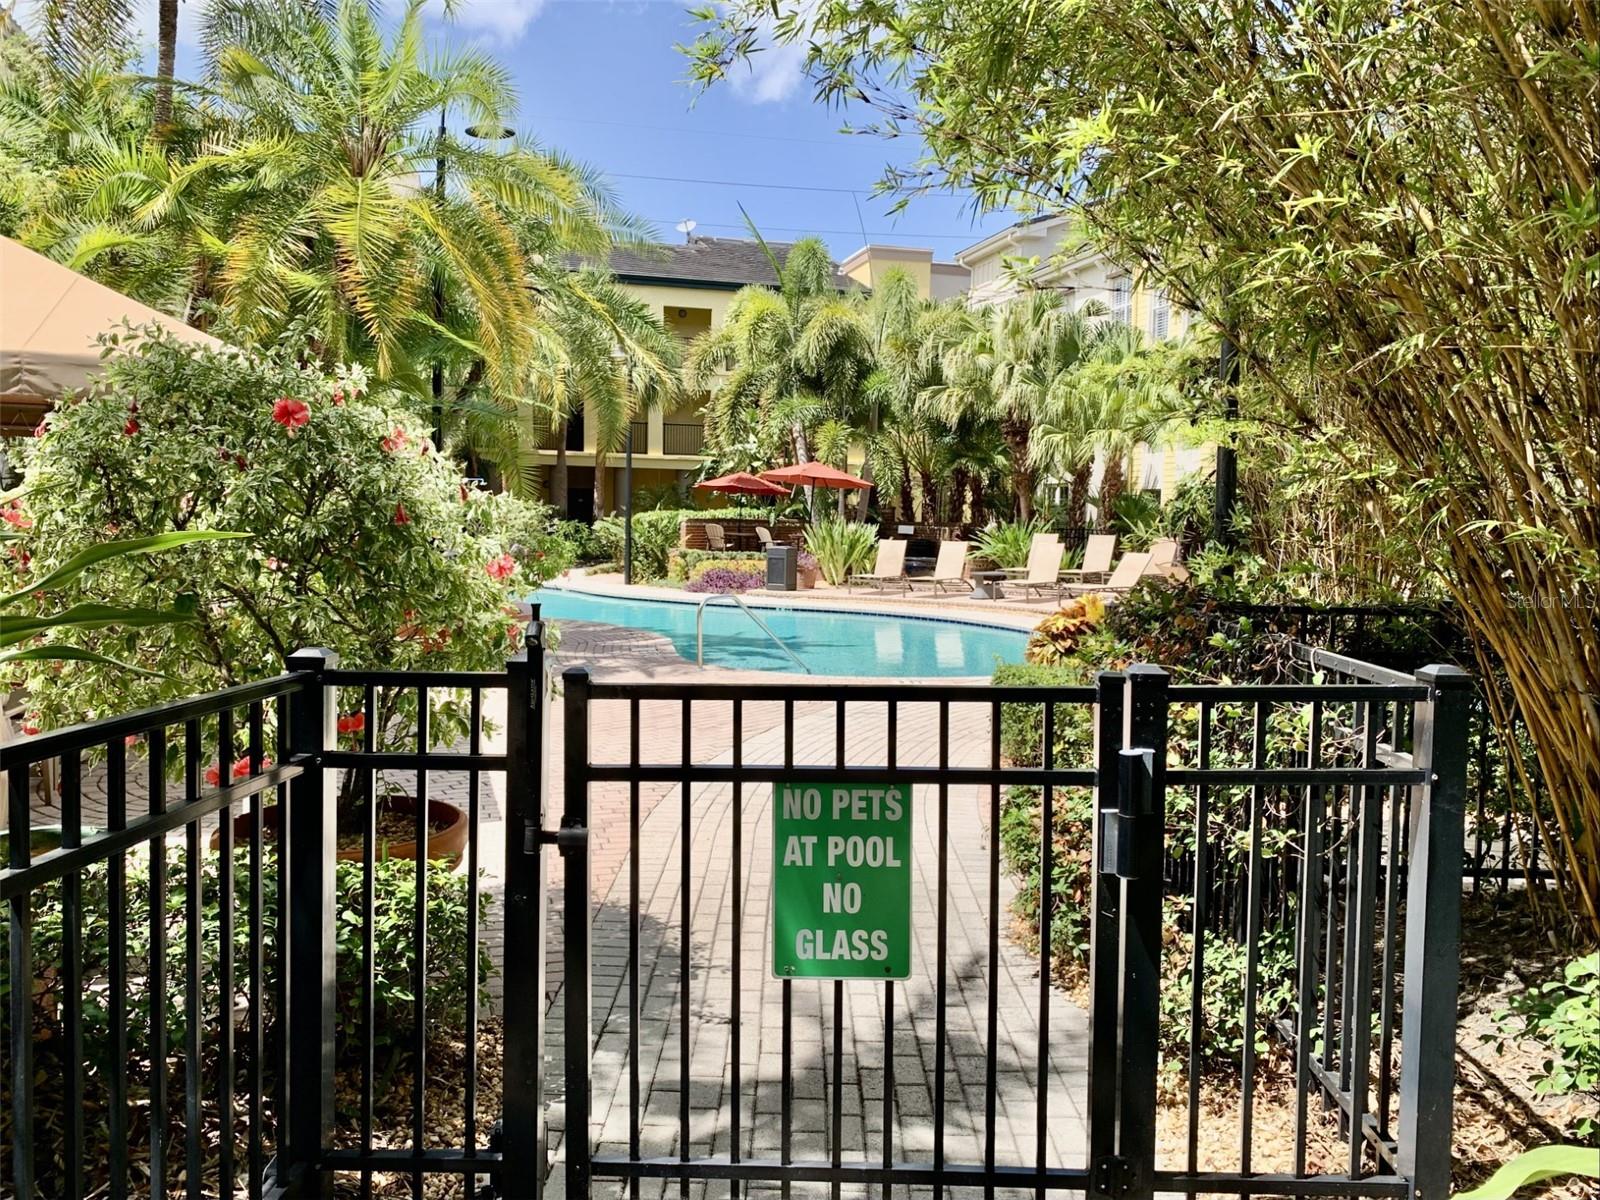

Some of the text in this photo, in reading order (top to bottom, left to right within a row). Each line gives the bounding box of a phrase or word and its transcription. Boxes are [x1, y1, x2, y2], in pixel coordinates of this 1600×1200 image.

[783, 788, 903, 821] NO PETS
[783, 835, 901, 868] AT POOL
[823, 882, 862, 914] NO
[795, 929, 889, 961] GLASS
